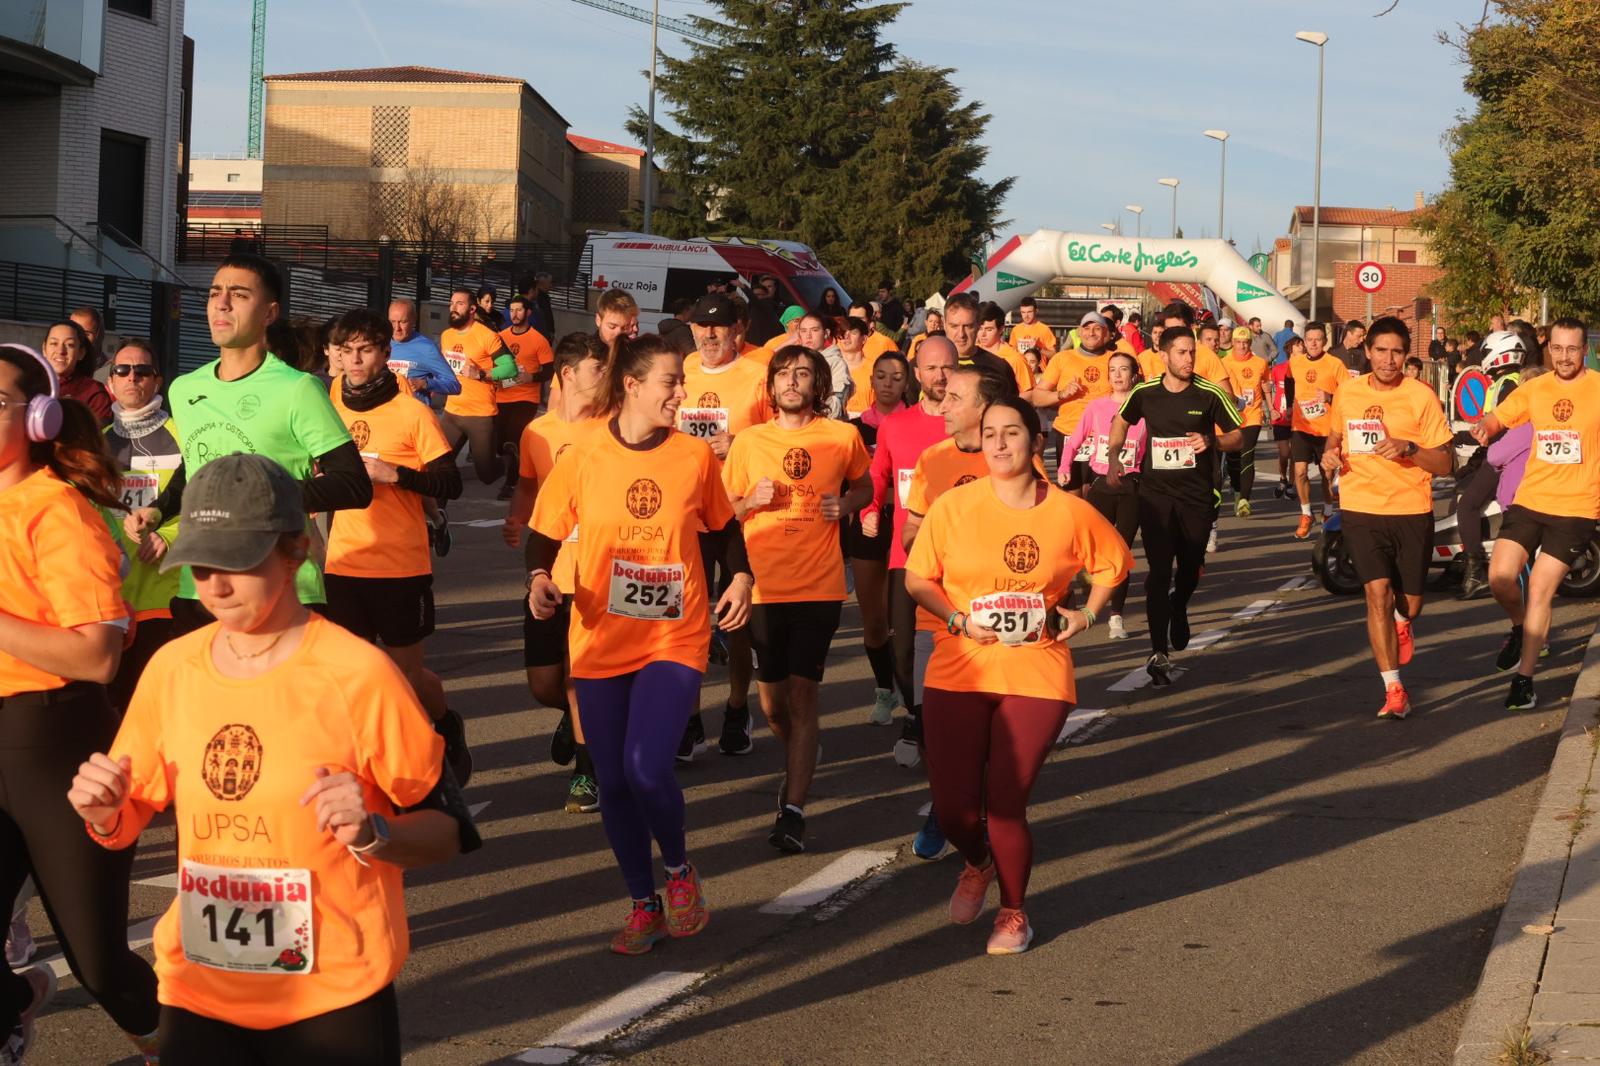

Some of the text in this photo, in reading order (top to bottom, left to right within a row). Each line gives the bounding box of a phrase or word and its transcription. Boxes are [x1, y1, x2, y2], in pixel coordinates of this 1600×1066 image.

[652, 243, 708, 254] AMBULANCIA
[1068, 241, 1198, 273] El Corte Inglés
[1362, 272, 1379, 283] 30
[611, 280, 658, 293] Cruz Roja
[225, 422, 257, 454] OSTEOPA
[1362, 431, 1379, 445] 70
[1537, 431, 1580, 441] beduia
[1163, 448, 1180, 462] 61
[1545, 441, 1572, 456] 376
[122, 489, 144, 507] 61
[777, 484, 816, 498] UPSA
[618, 525, 665, 541] UPSA
[613, 562, 683, 583] bedunia
[994, 577, 1037, 592] UPSA
[624, 582, 670, 607] 252
[988, 611, 1029, 633] 251
[192, 813, 272, 844] UPSA
[181, 867, 308, 903] bedunia
[202, 903, 276, 948] 141
